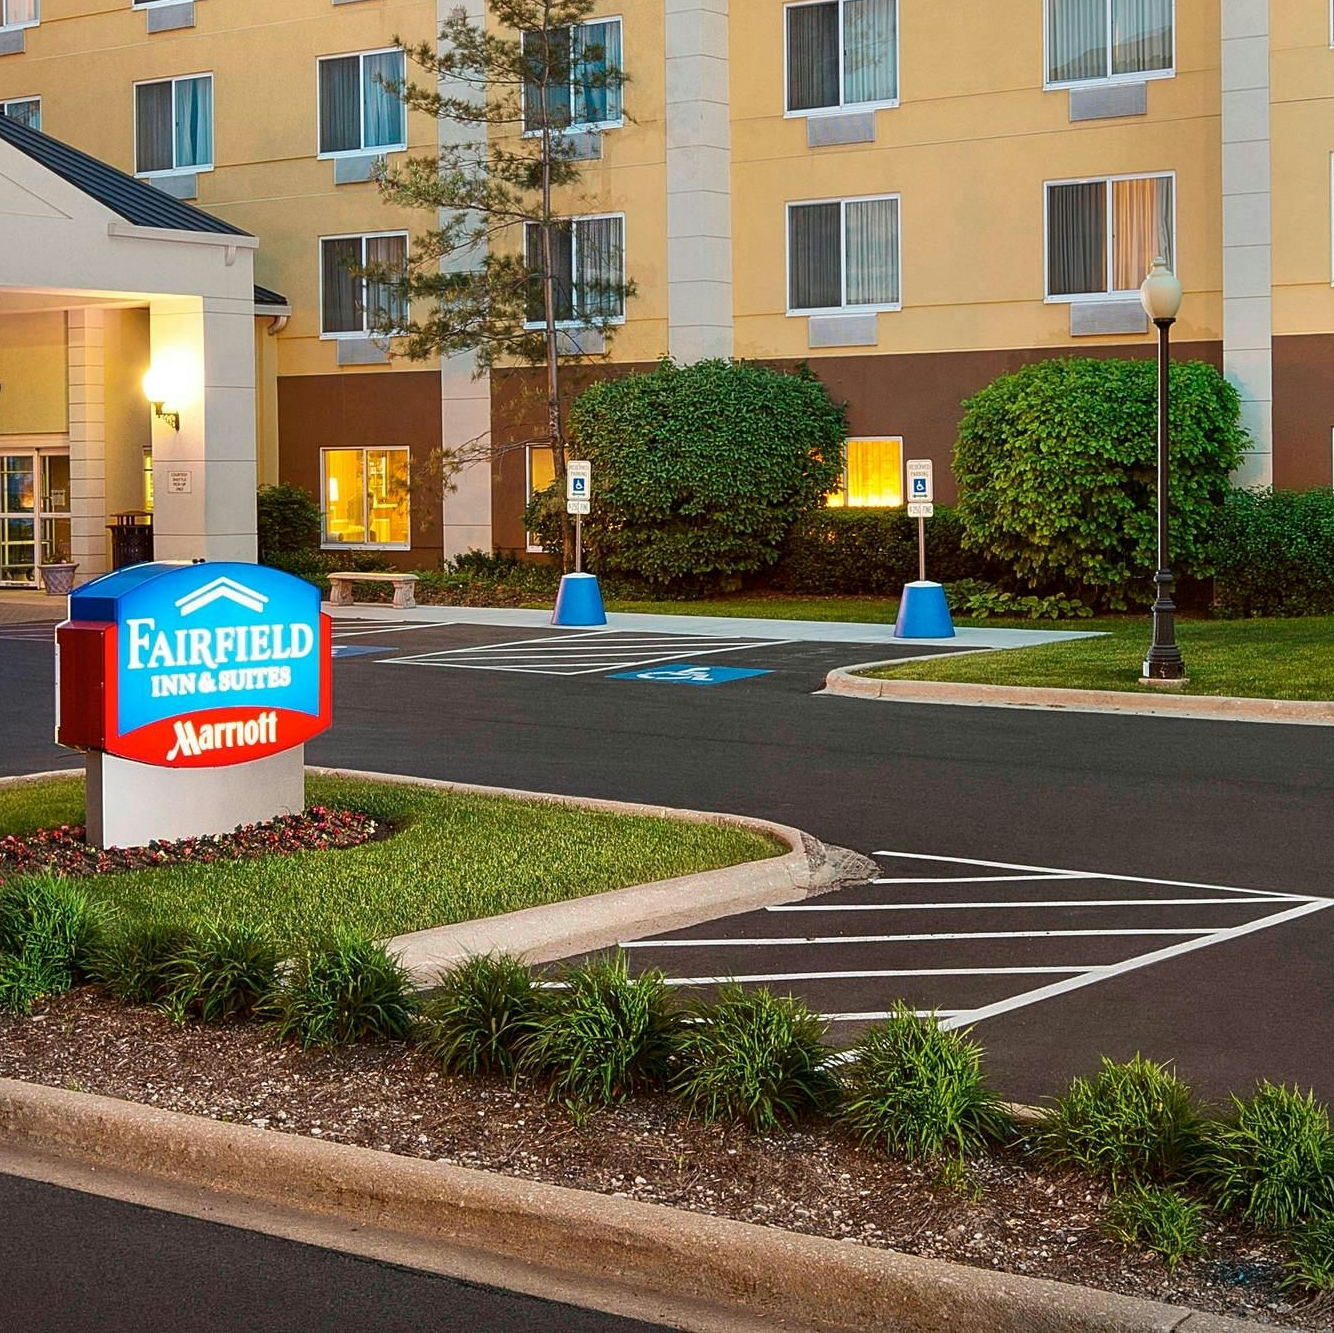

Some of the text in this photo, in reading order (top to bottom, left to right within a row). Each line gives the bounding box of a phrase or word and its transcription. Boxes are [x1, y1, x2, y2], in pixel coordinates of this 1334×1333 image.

[126, 617, 315, 670] FAIRFIELD
[151, 666, 292, 698] INN & SUITES
[166, 711, 278, 762] Marriott
